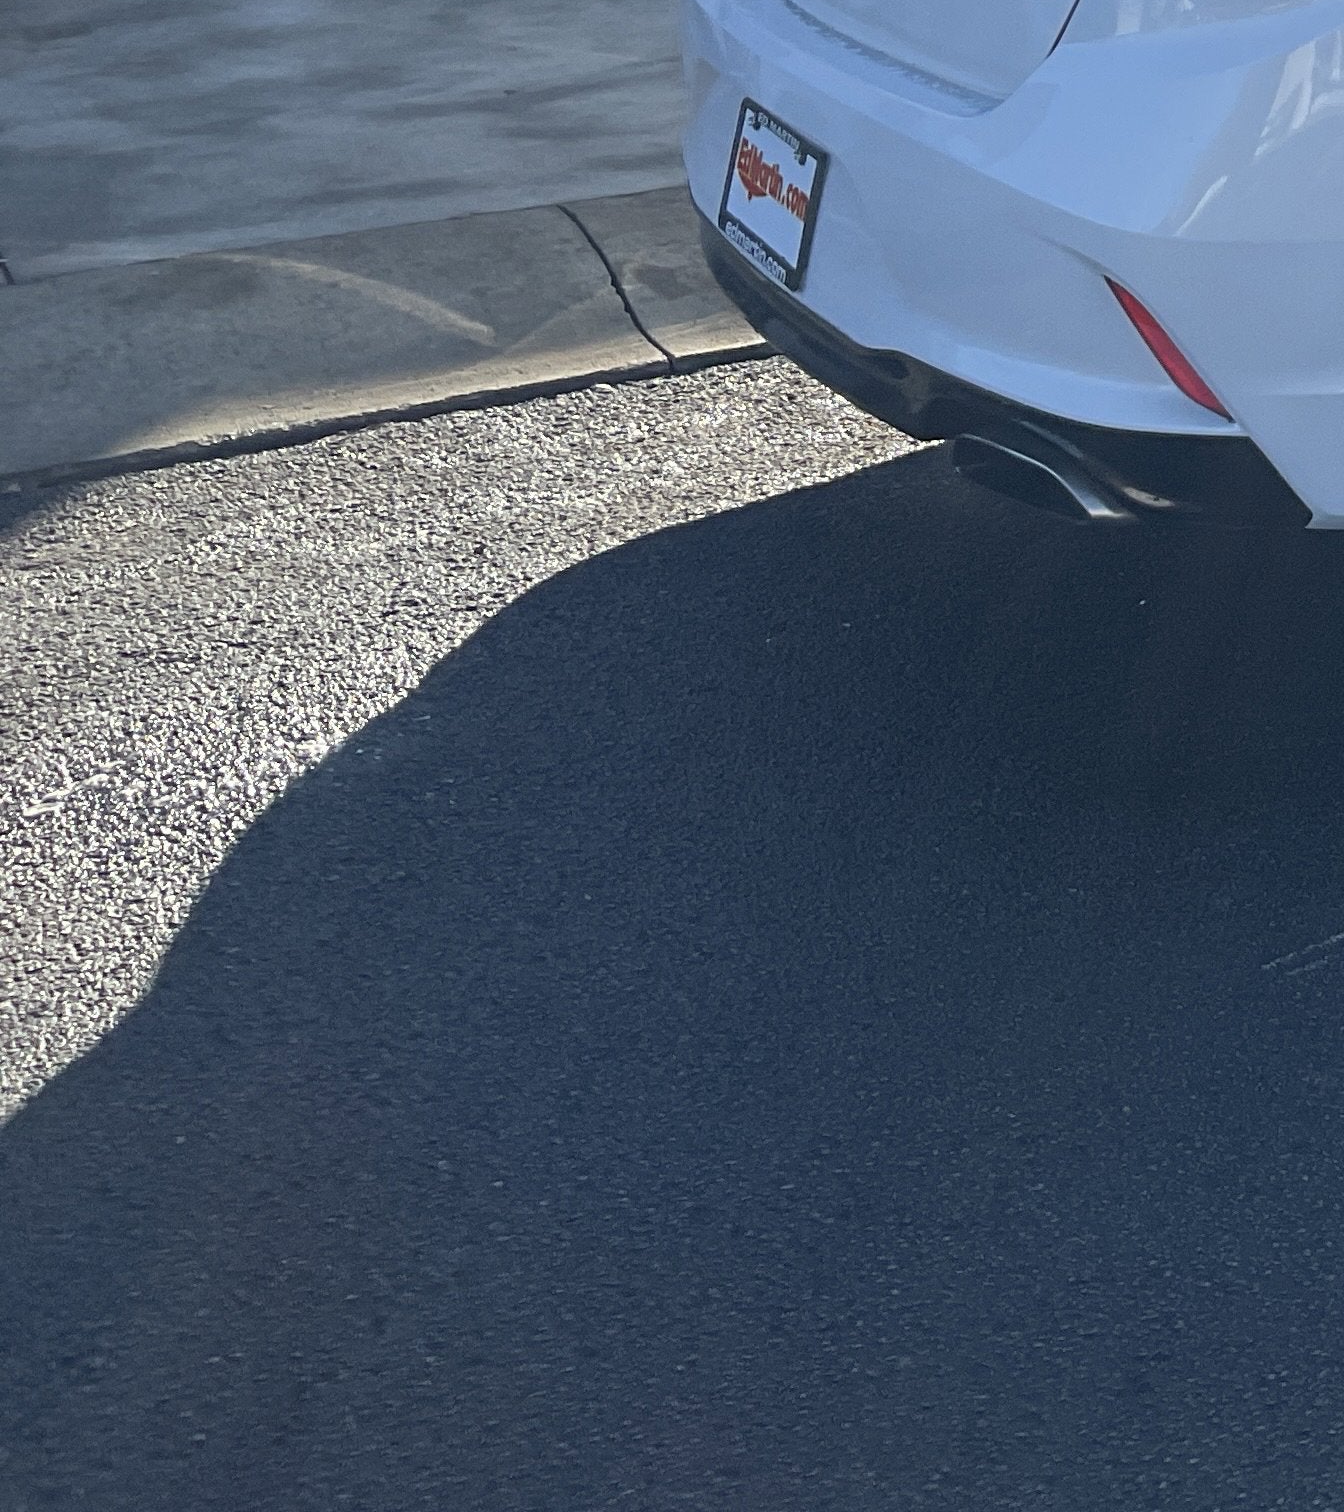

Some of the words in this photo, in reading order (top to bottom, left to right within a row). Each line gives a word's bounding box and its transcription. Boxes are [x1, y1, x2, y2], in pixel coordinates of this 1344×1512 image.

[757, 112, 769, 128] ED
[770, 120, 801, 150] MARTIN
[724, 220, 787, 284] edmartin.com
